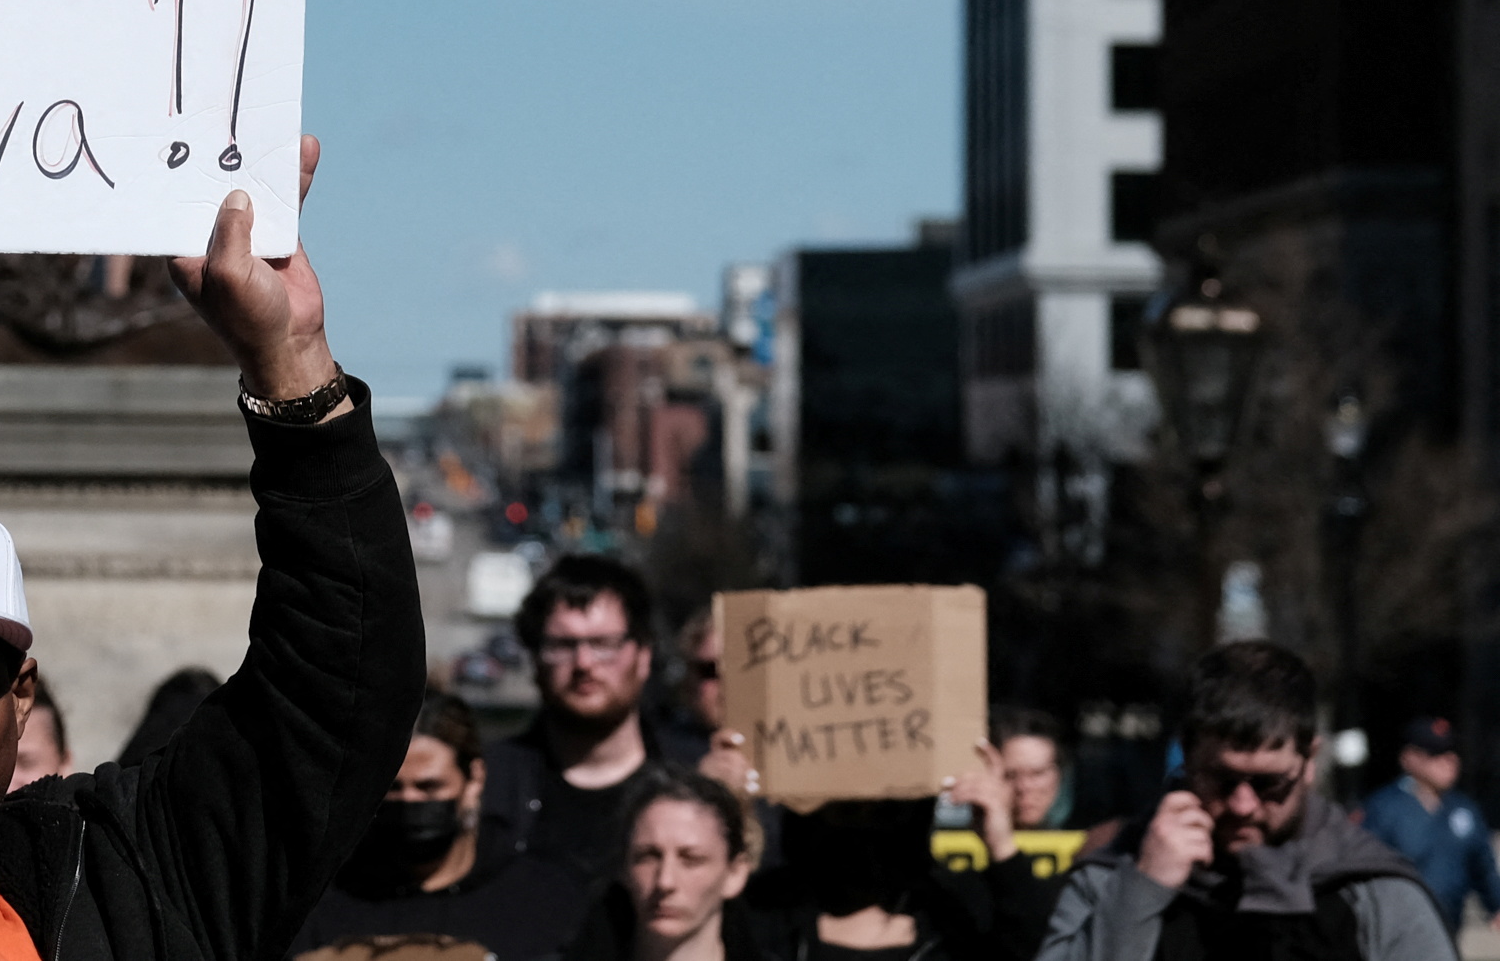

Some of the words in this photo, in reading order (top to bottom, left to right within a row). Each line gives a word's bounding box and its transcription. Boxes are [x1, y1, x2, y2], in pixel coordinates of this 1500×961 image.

[740, 616, 881, 671] BLACK
[801, 668, 914, 709] LIVES
[752, 708, 935, 770] MATTER
